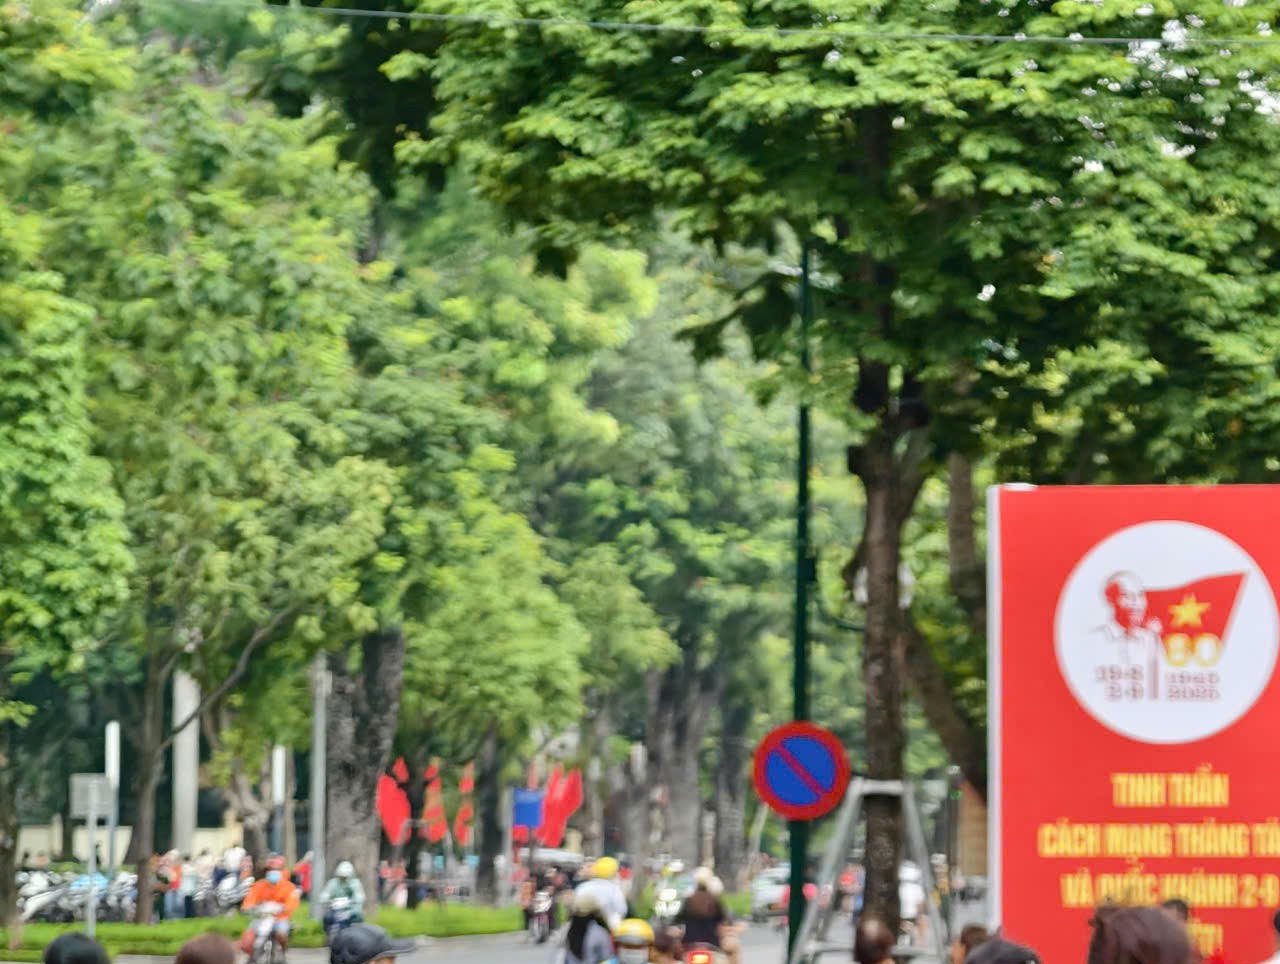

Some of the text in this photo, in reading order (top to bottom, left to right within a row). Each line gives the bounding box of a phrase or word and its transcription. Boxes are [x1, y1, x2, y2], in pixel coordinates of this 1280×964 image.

[1165, 633, 1221, 667] 80
[1110, 772, 1166, 807] TINH
[1037, 816, 1100, 858] CÁCH
[1175, 816, 1250, 858] THÁNG
[1239, 874, 1280, 908] 2-9
